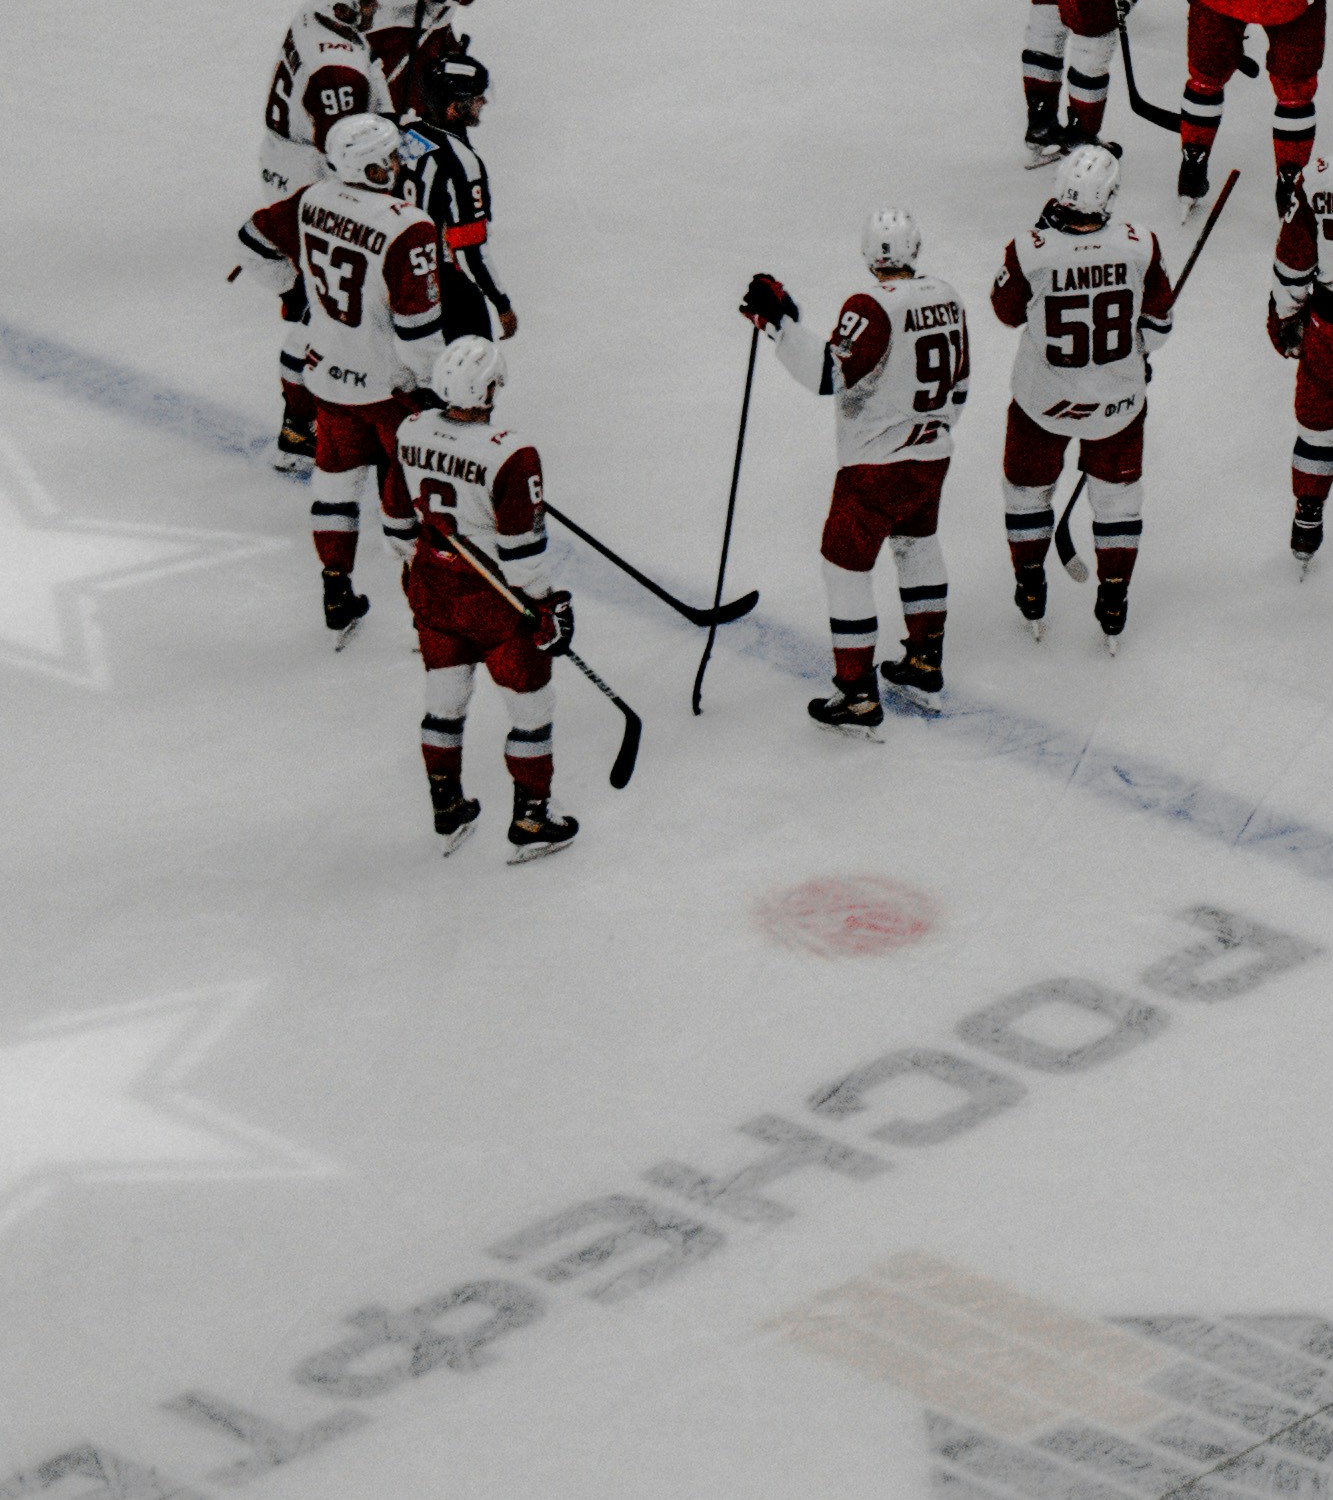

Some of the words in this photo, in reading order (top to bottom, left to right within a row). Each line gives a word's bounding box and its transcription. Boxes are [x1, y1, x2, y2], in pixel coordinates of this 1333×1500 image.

[319, 84, 355, 116] 96
[304, 231, 368, 329] 53
[1051, 261, 1128, 293] LANDER
[836, 309, 870, 342] 91
[1044, 288, 1134, 369] 58
